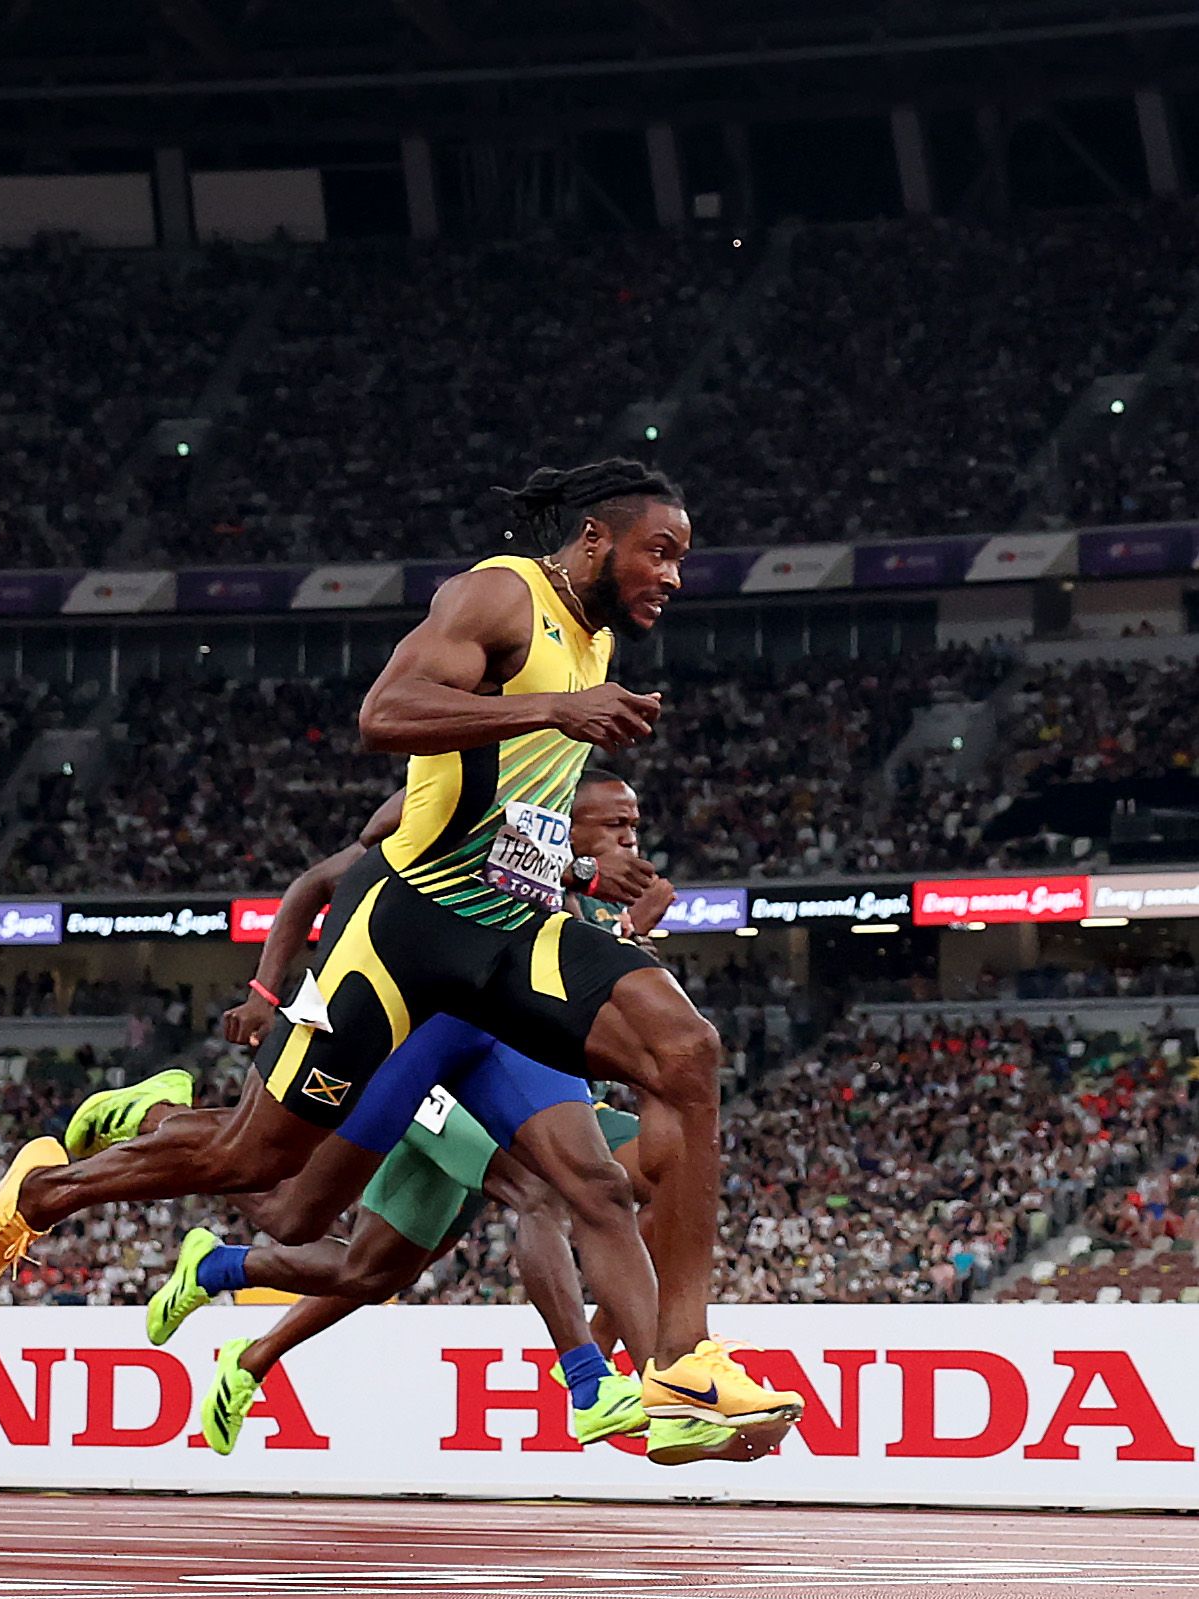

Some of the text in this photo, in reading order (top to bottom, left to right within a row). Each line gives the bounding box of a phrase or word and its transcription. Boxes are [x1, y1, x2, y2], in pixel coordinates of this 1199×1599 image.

[536, 813, 568, 848] TD
[751, 899, 797, 922] Every
[922, 893, 969, 916] Every
[1095, 887, 1144, 911] Every
[66, 913, 114, 936] Every
[440, 1347, 1195, 1462] HNDA
